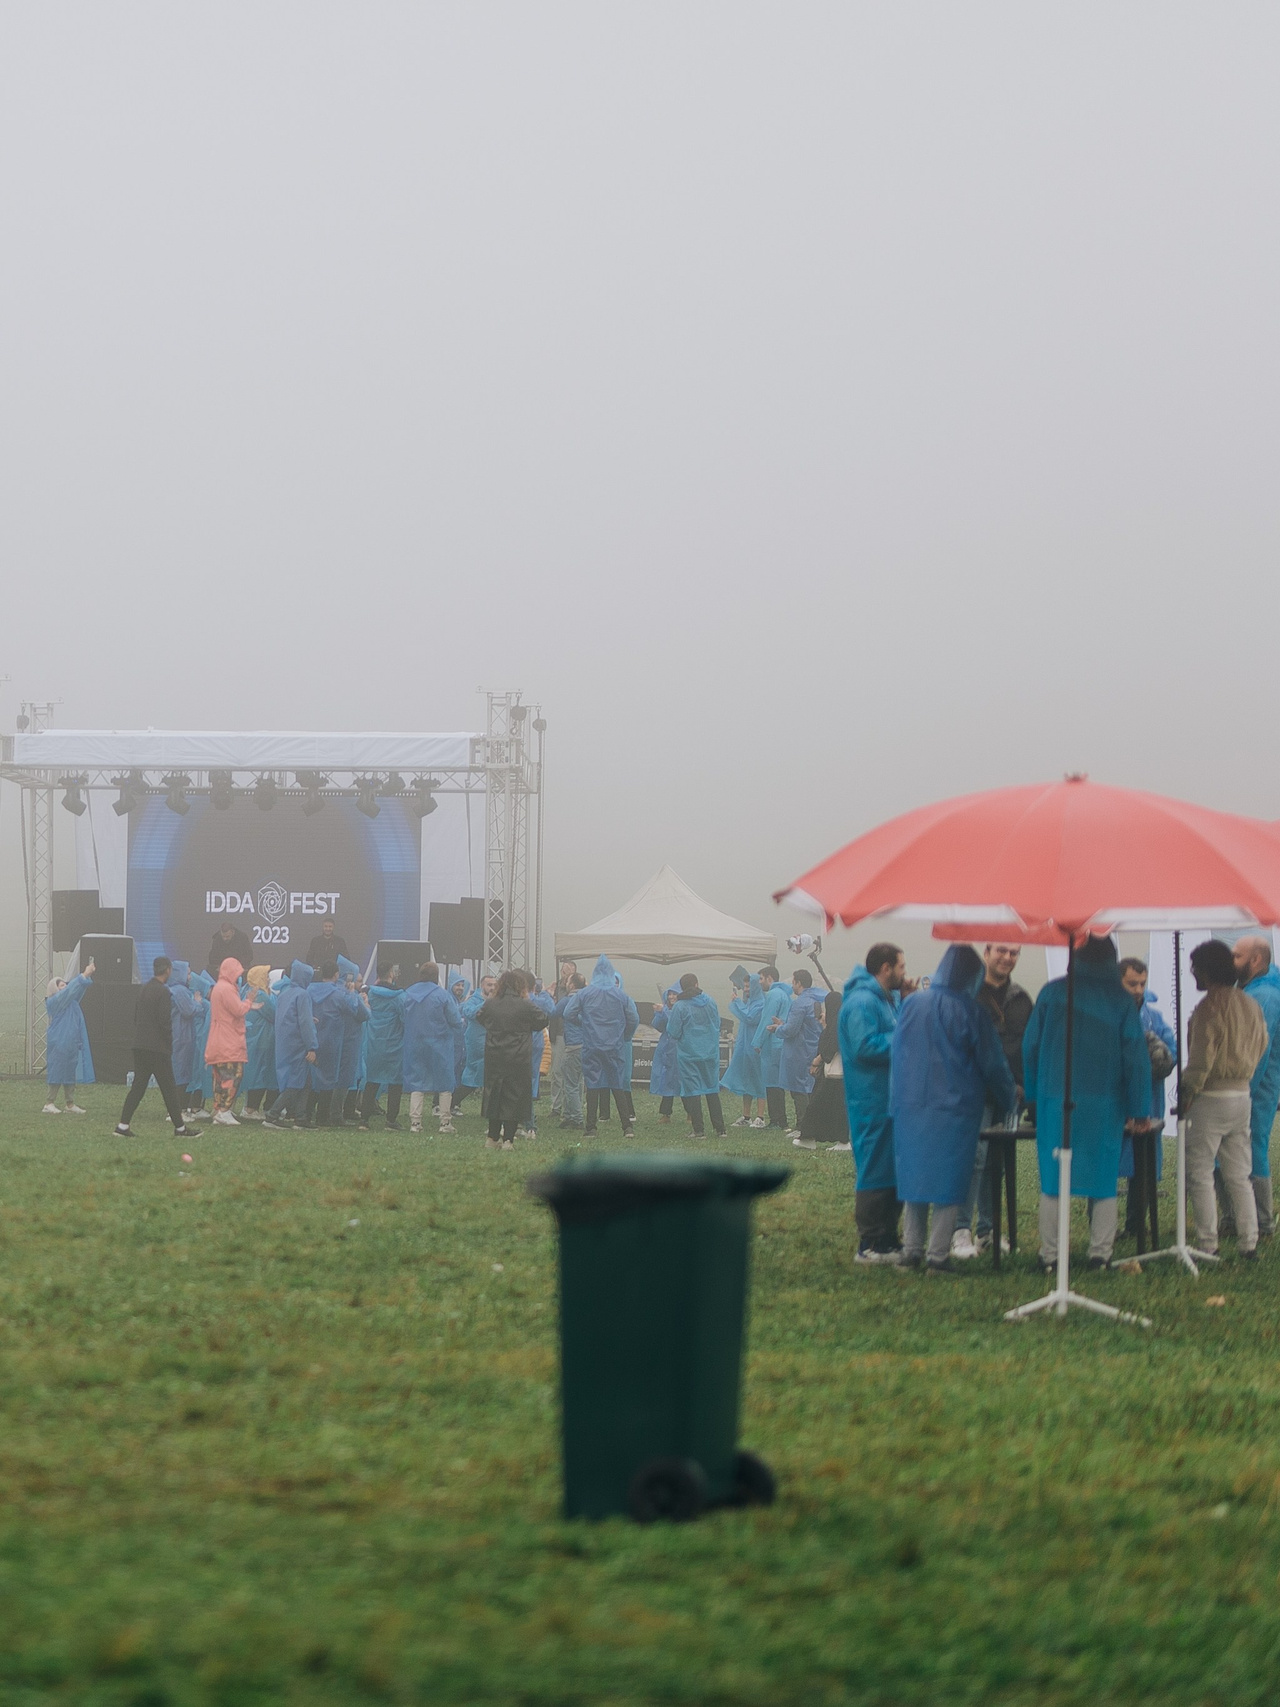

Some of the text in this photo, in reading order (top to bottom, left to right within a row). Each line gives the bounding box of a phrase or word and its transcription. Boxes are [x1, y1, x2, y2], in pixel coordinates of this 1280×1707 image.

[206, 891, 340, 914] IDDA FEST
[252, 926, 290, 944] 2023
